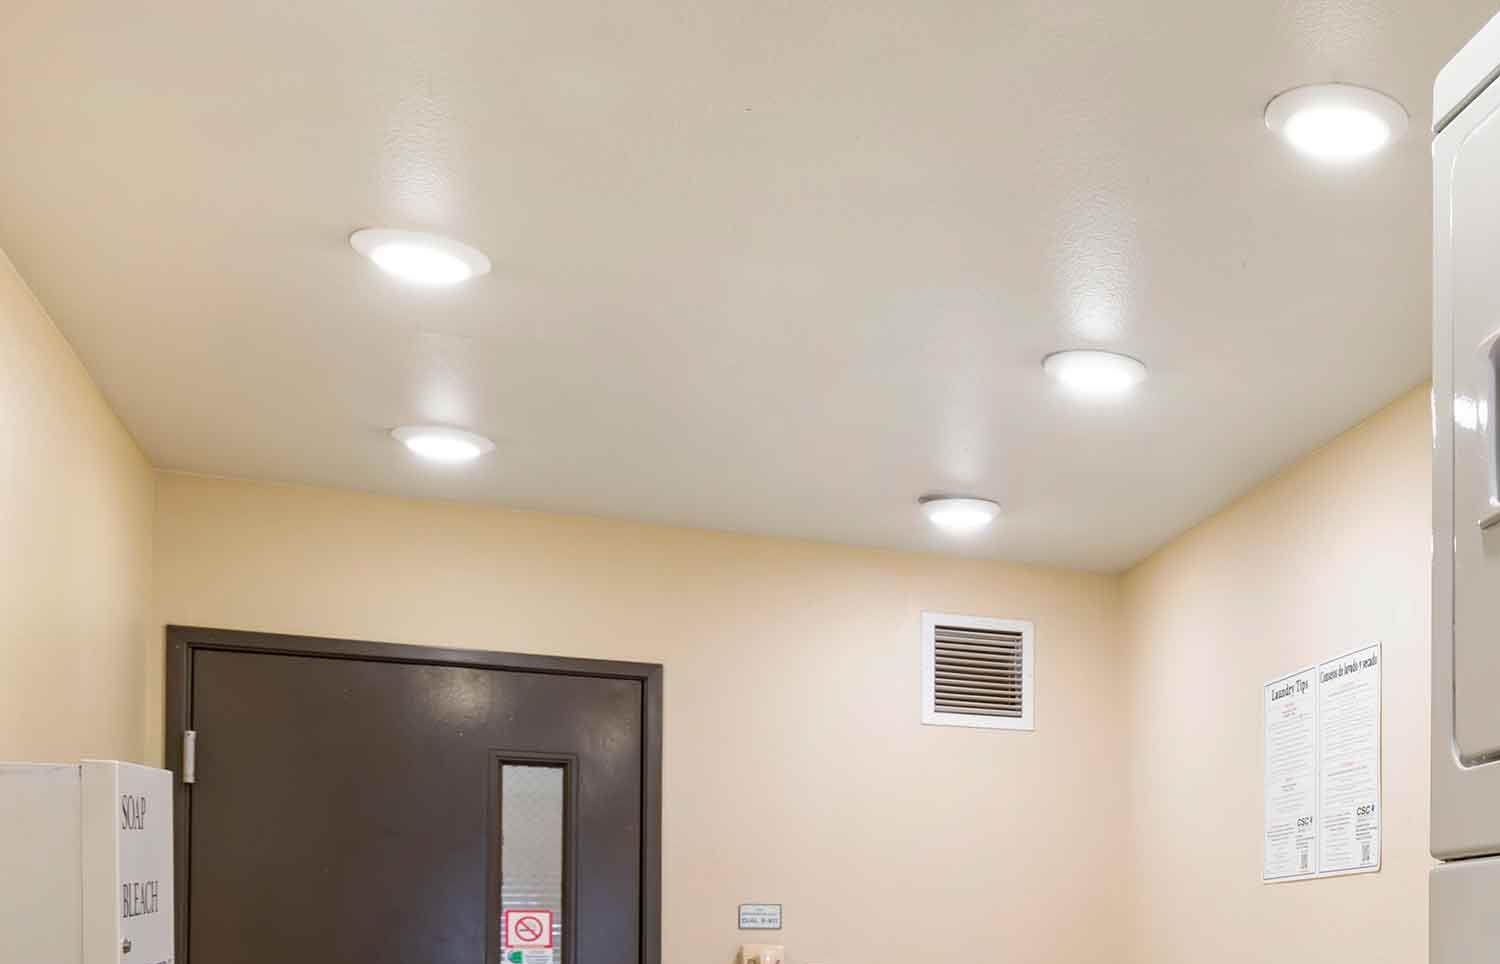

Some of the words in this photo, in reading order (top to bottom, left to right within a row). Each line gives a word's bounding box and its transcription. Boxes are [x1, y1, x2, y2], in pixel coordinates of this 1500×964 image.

[1271, 683, 1295, 702] Laundry
[121, 794, 146, 830] SOAP
[1356, 804, 1371, 816] CSC
[122, 880, 159, 918] BLEACH
